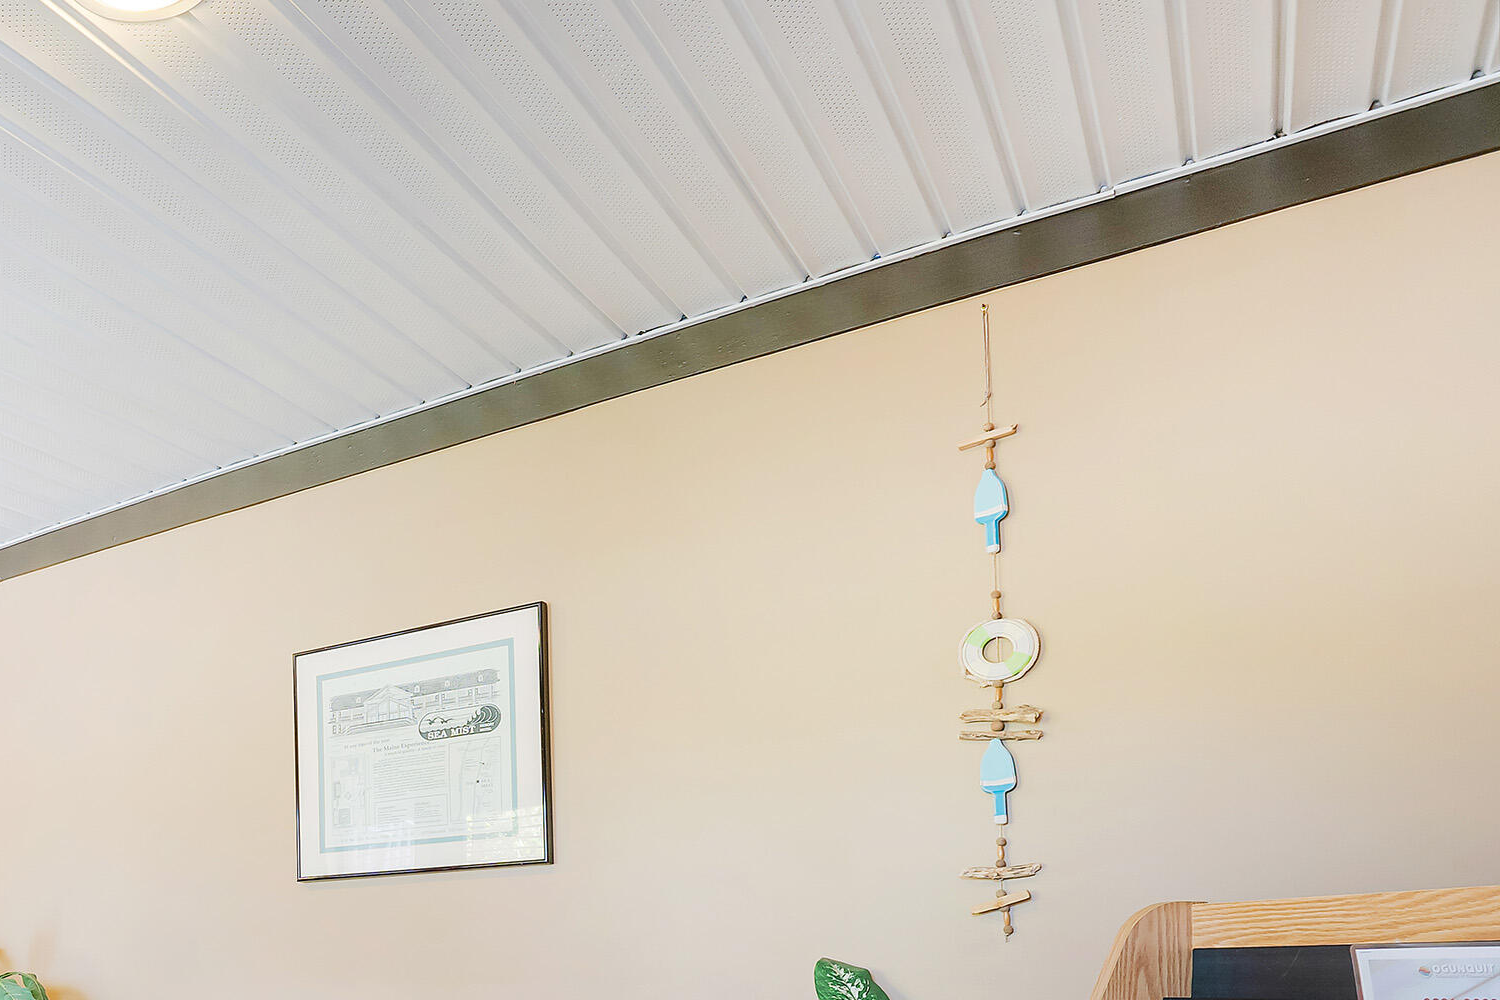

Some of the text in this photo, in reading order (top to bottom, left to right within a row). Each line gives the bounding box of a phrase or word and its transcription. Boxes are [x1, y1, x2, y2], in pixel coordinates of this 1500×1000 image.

[428, 730, 448, 740] SEA
[451, 726, 477, 738] MIST
[1432, 964, 1494, 974] OGUNQUIT
